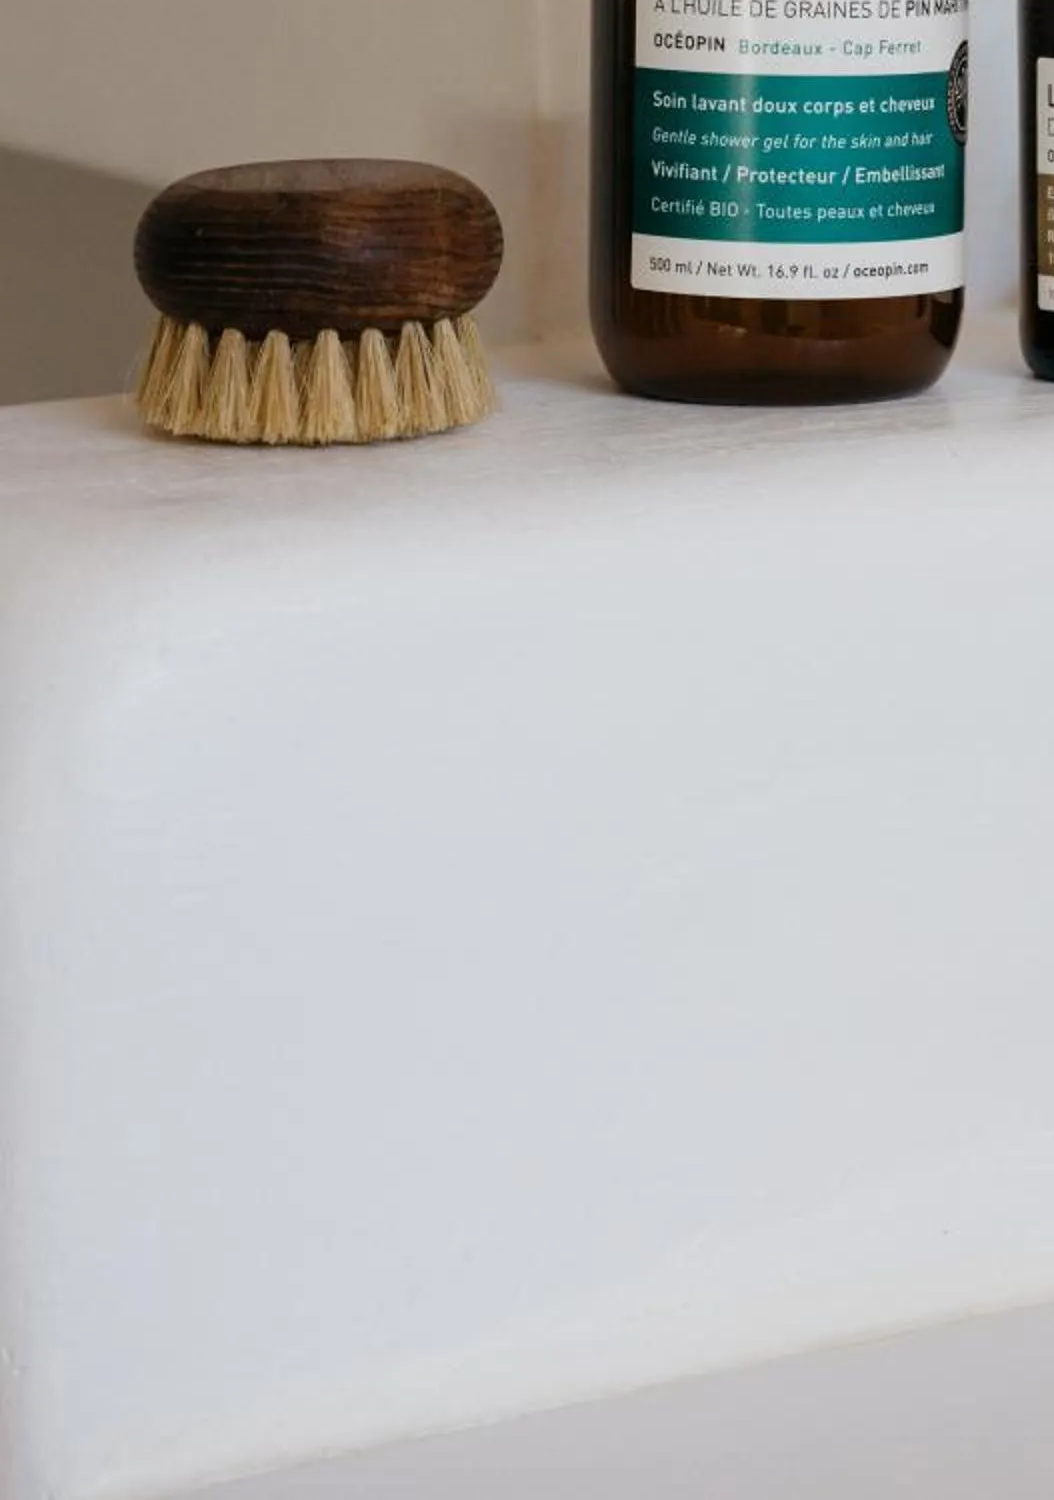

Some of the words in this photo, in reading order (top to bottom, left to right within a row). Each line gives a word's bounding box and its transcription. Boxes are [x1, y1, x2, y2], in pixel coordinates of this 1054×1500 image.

[750, 0, 777, 19] DE
[783, 0, 872, 19] GRAINES
[879, 0, 901, 18] DE
[653, 30, 725, 52] OCÉOPIN
[739, 37, 823, 56] Bordeaux
[843, 39, 873, 59] Cap
[879, 39, 922, 56] Ferret
[652, 90, 687, 110] Soin
[692, 92, 747, 113] lavant
[752, 95, 797, 114] doux
[803, 100, 854, 118] corps
[859, 98, 876, 113] et
[880, 96, 935, 113] cheveux
[652, 127, 696, 146] Gentle
[700, 130, 757, 149] shower
[763, 133, 789, 153] gel
[793, 133, 817, 150] for
[821, 133, 847, 149] the
[851, 132, 880, 148] skin
[884, 131, 909, 147] and
[911, 131, 933, 146] hair
[651, 160, 717, 182] Vivifiant
[721, 164, 731, 184] /
[737, 164, 836, 185] Protecteur
[842, 165, 851, 186] /
[855, 163, 945, 184] Embellissant
[651, 197, 704, 216] Certifié
[709, 201, 738, 217] BIO
[757, 202, 812, 219] Toutes
[817, 206, 865, 222] peaux
[869, 203, 883, 218] et
[887, 201, 935, 217] cheveux
[649, 257, 671, 273] 500
[675, 261, 692, 274] ml
[695, 260, 703, 276] /
[707, 262, 732, 277] Net
[737, 263, 761, 278] Wt.
[768, 264, 798, 280] 16.9
[823, 267, 840, 279] oz
[843, 262, 850, 279] /
[853, 261, 929, 282] oceopin.com
